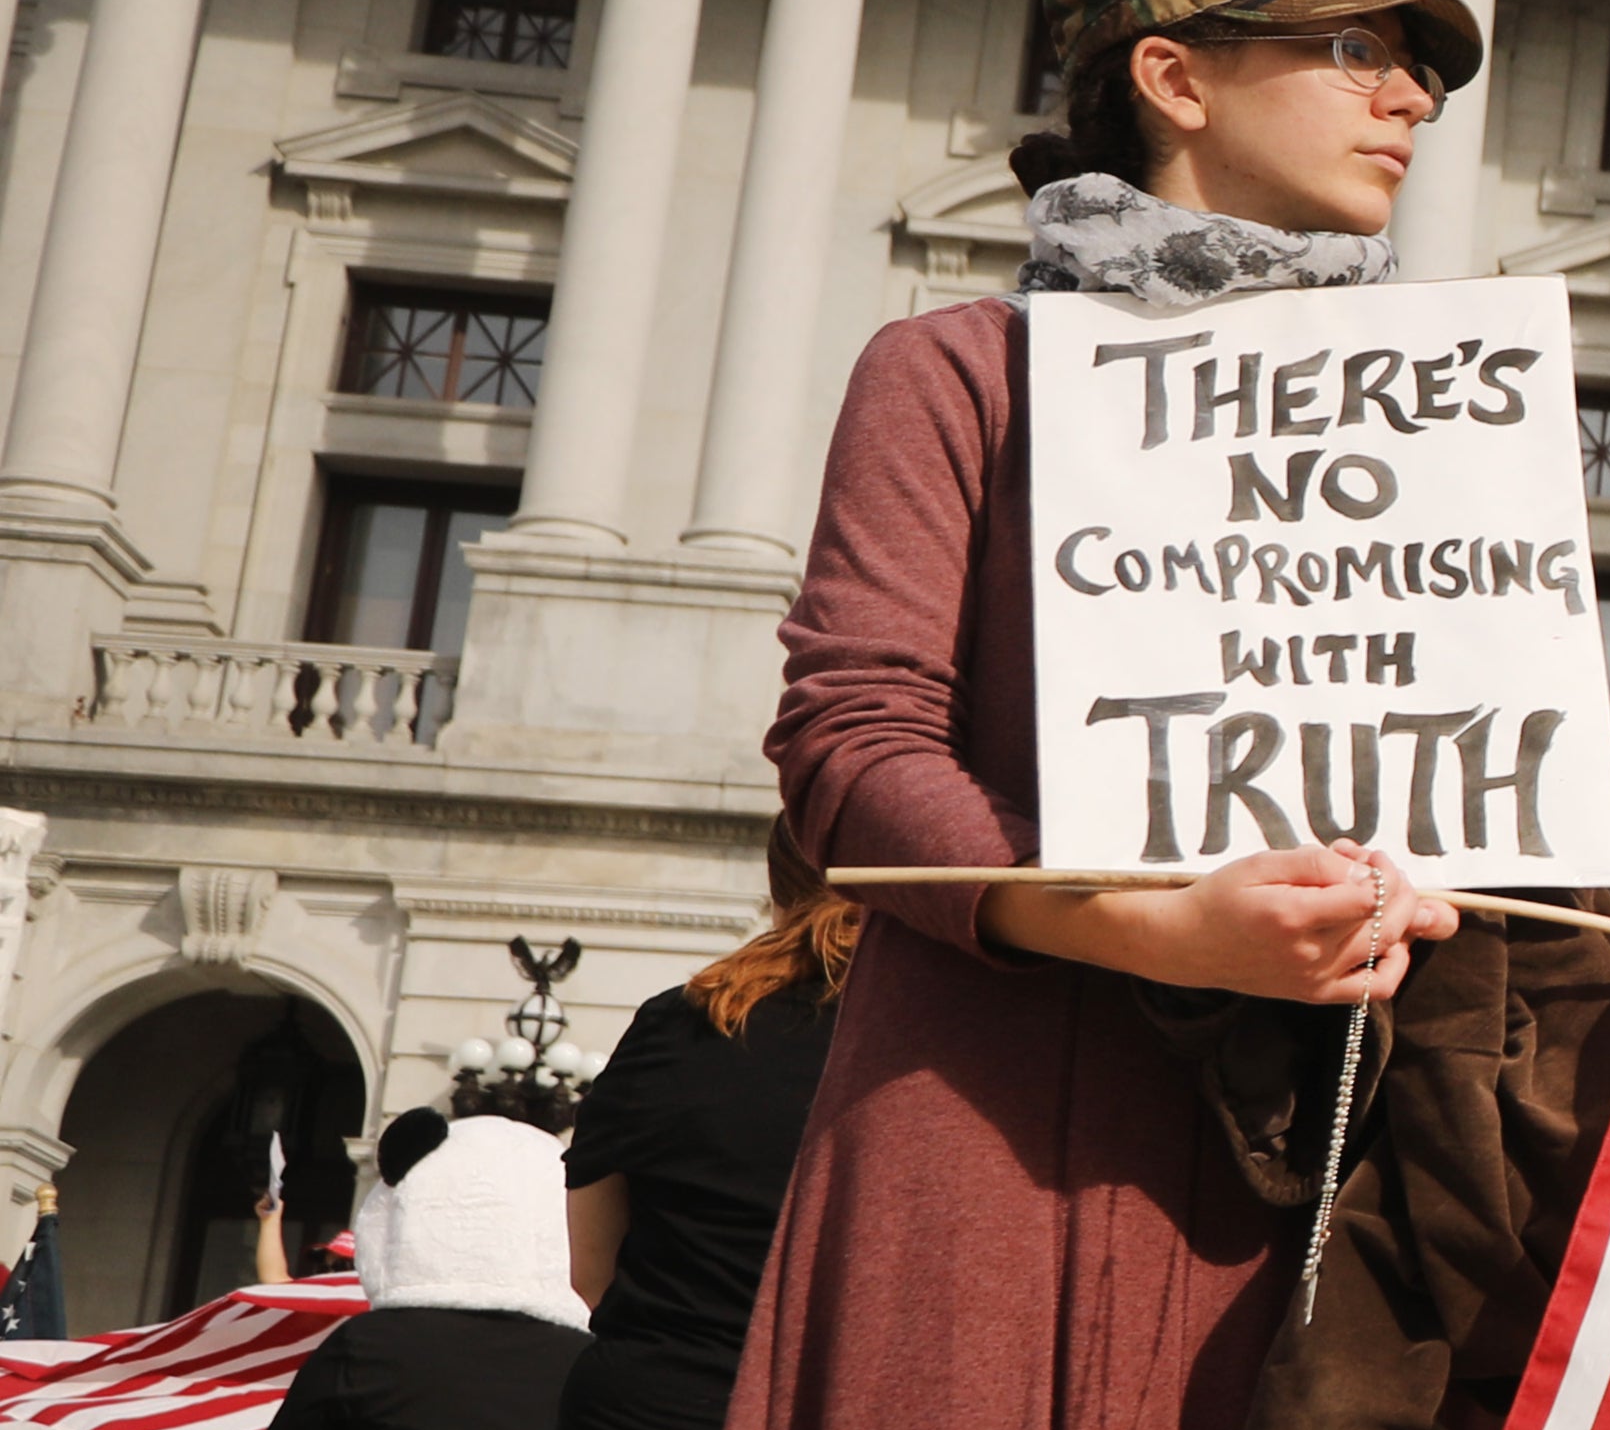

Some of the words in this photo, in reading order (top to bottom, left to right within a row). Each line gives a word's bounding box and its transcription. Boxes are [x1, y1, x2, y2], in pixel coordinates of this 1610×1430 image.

[1093, 330, 1544, 451] THERE'S
[1226, 449, 1398, 522] NO
[1055, 526, 1586, 616] COMPROMISING
[1221, 631, 1416, 687] WITH
[1085, 691, 1568, 862] TRUTH
